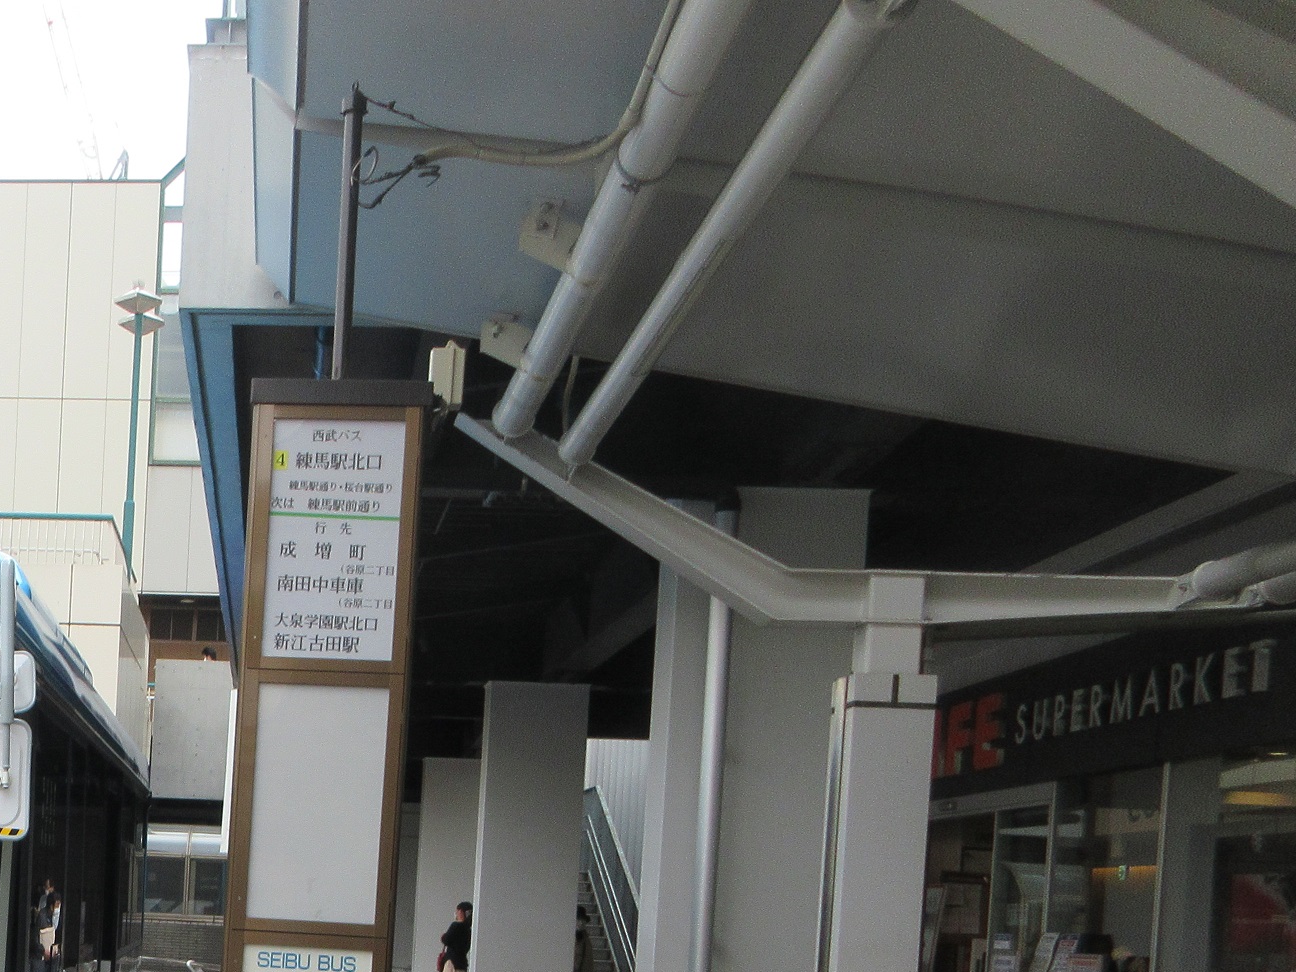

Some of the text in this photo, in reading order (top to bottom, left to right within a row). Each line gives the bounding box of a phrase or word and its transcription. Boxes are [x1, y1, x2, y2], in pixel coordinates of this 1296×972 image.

[312, 429, 362, 442] 西武バス
[276, 452, 383, 471] 4 練馬駅北口
[271, 497, 294, 509] 次は
[279, 541, 366, 561] 成増町
[277, 575, 364, 594] 南田中車庫
[274, 614, 378, 631] 大泉学園駅北口
[273, 633, 360, 653] 新江古田駅
[1014, 638, 1278, 744] SUPERMARKET
[257, 951, 356, 972] SEIBU BUS
